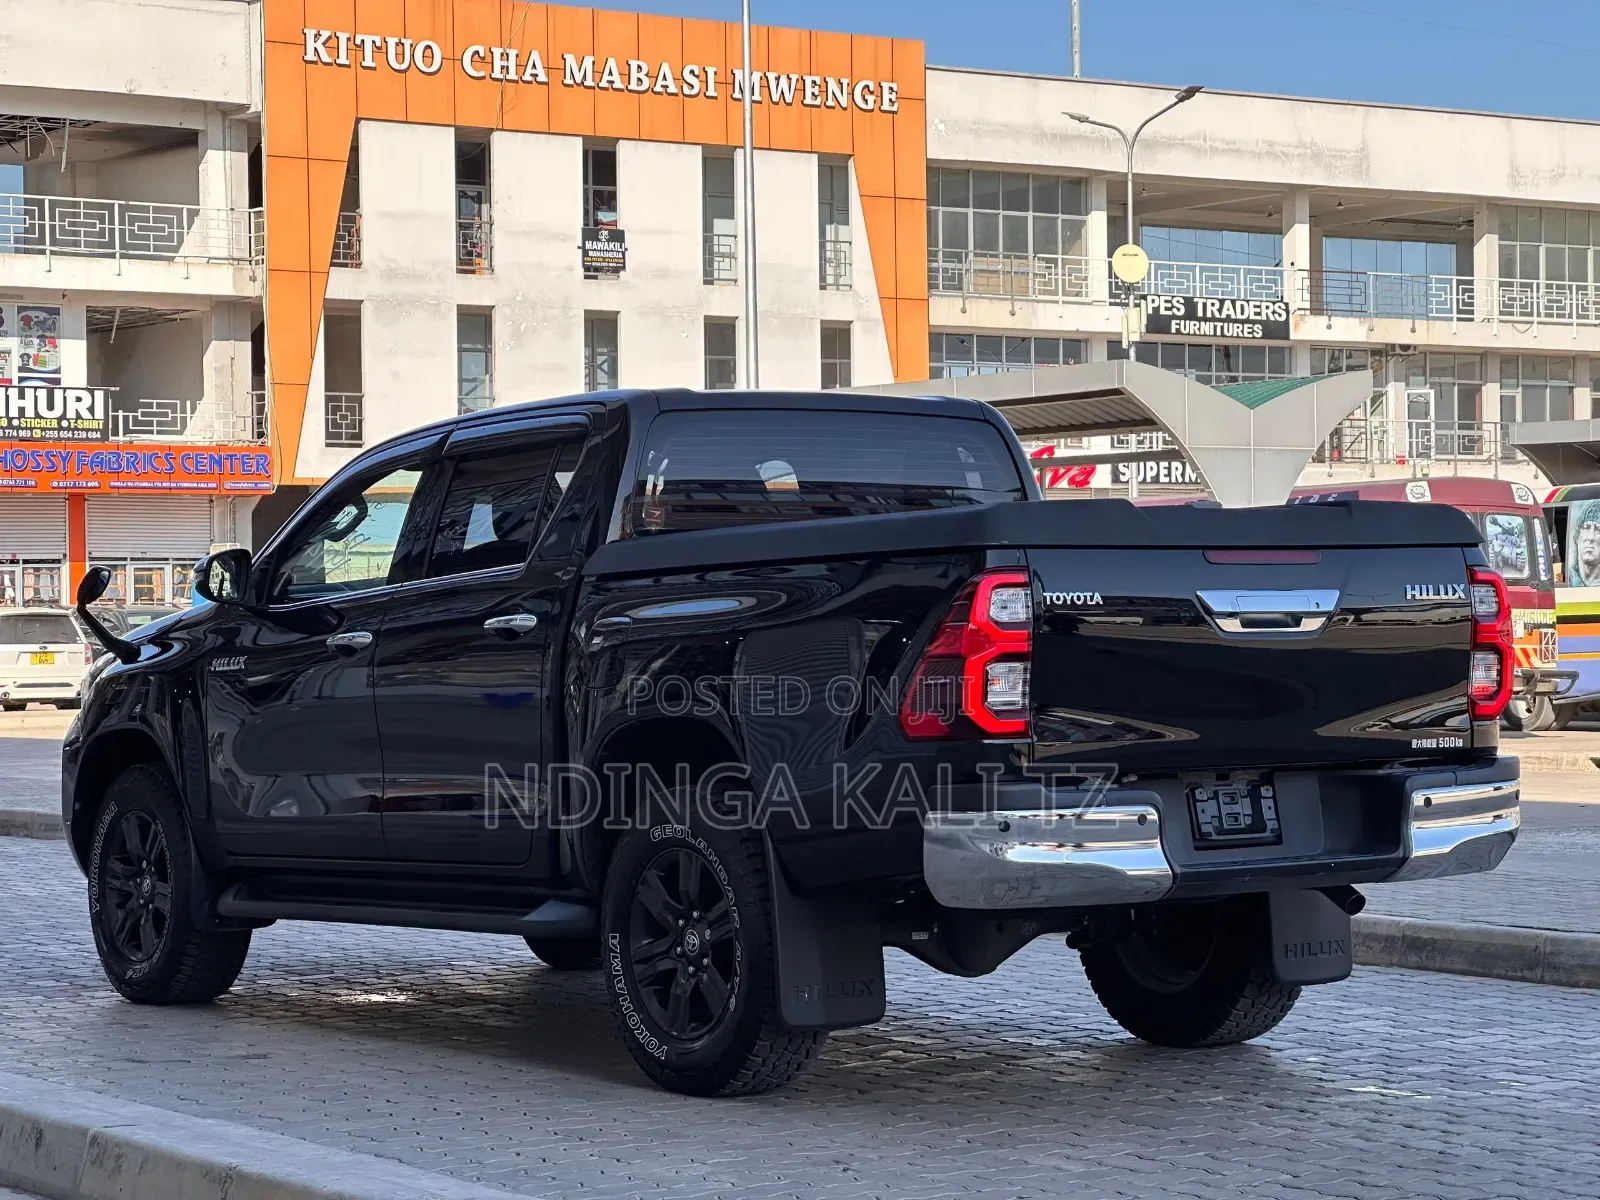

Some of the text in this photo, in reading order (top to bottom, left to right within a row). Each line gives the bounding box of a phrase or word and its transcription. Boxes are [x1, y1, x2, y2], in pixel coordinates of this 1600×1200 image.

[302, 27, 900, 113] KITUO CHA MABASI MWENGE
[585, 241, 625, 251] MAWAKILI
[1147, 294, 1287, 322] PES TRADERS
[1170, 320, 1263, 338] FURNITURES
[20, 418, 58, 428] STICKER
[69, 420, 104, 429] T-SHIRT
[5, 429, 17, 437] 774
[18, 429, 31, 438] 969
[75, 449, 176, 476] FABRICS
[180, 452, 271, 478] CENTER
[1043, 591, 1103, 605] TOYOTA
[1405, 584, 1466, 600] HILUX
[210, 655, 248, 671] HILUX
[1284, 939, 1347, 959] HILUX
[608, 933, 668, 1060] YOKOHAMA
[792, 978, 876, 1004] HILUX
